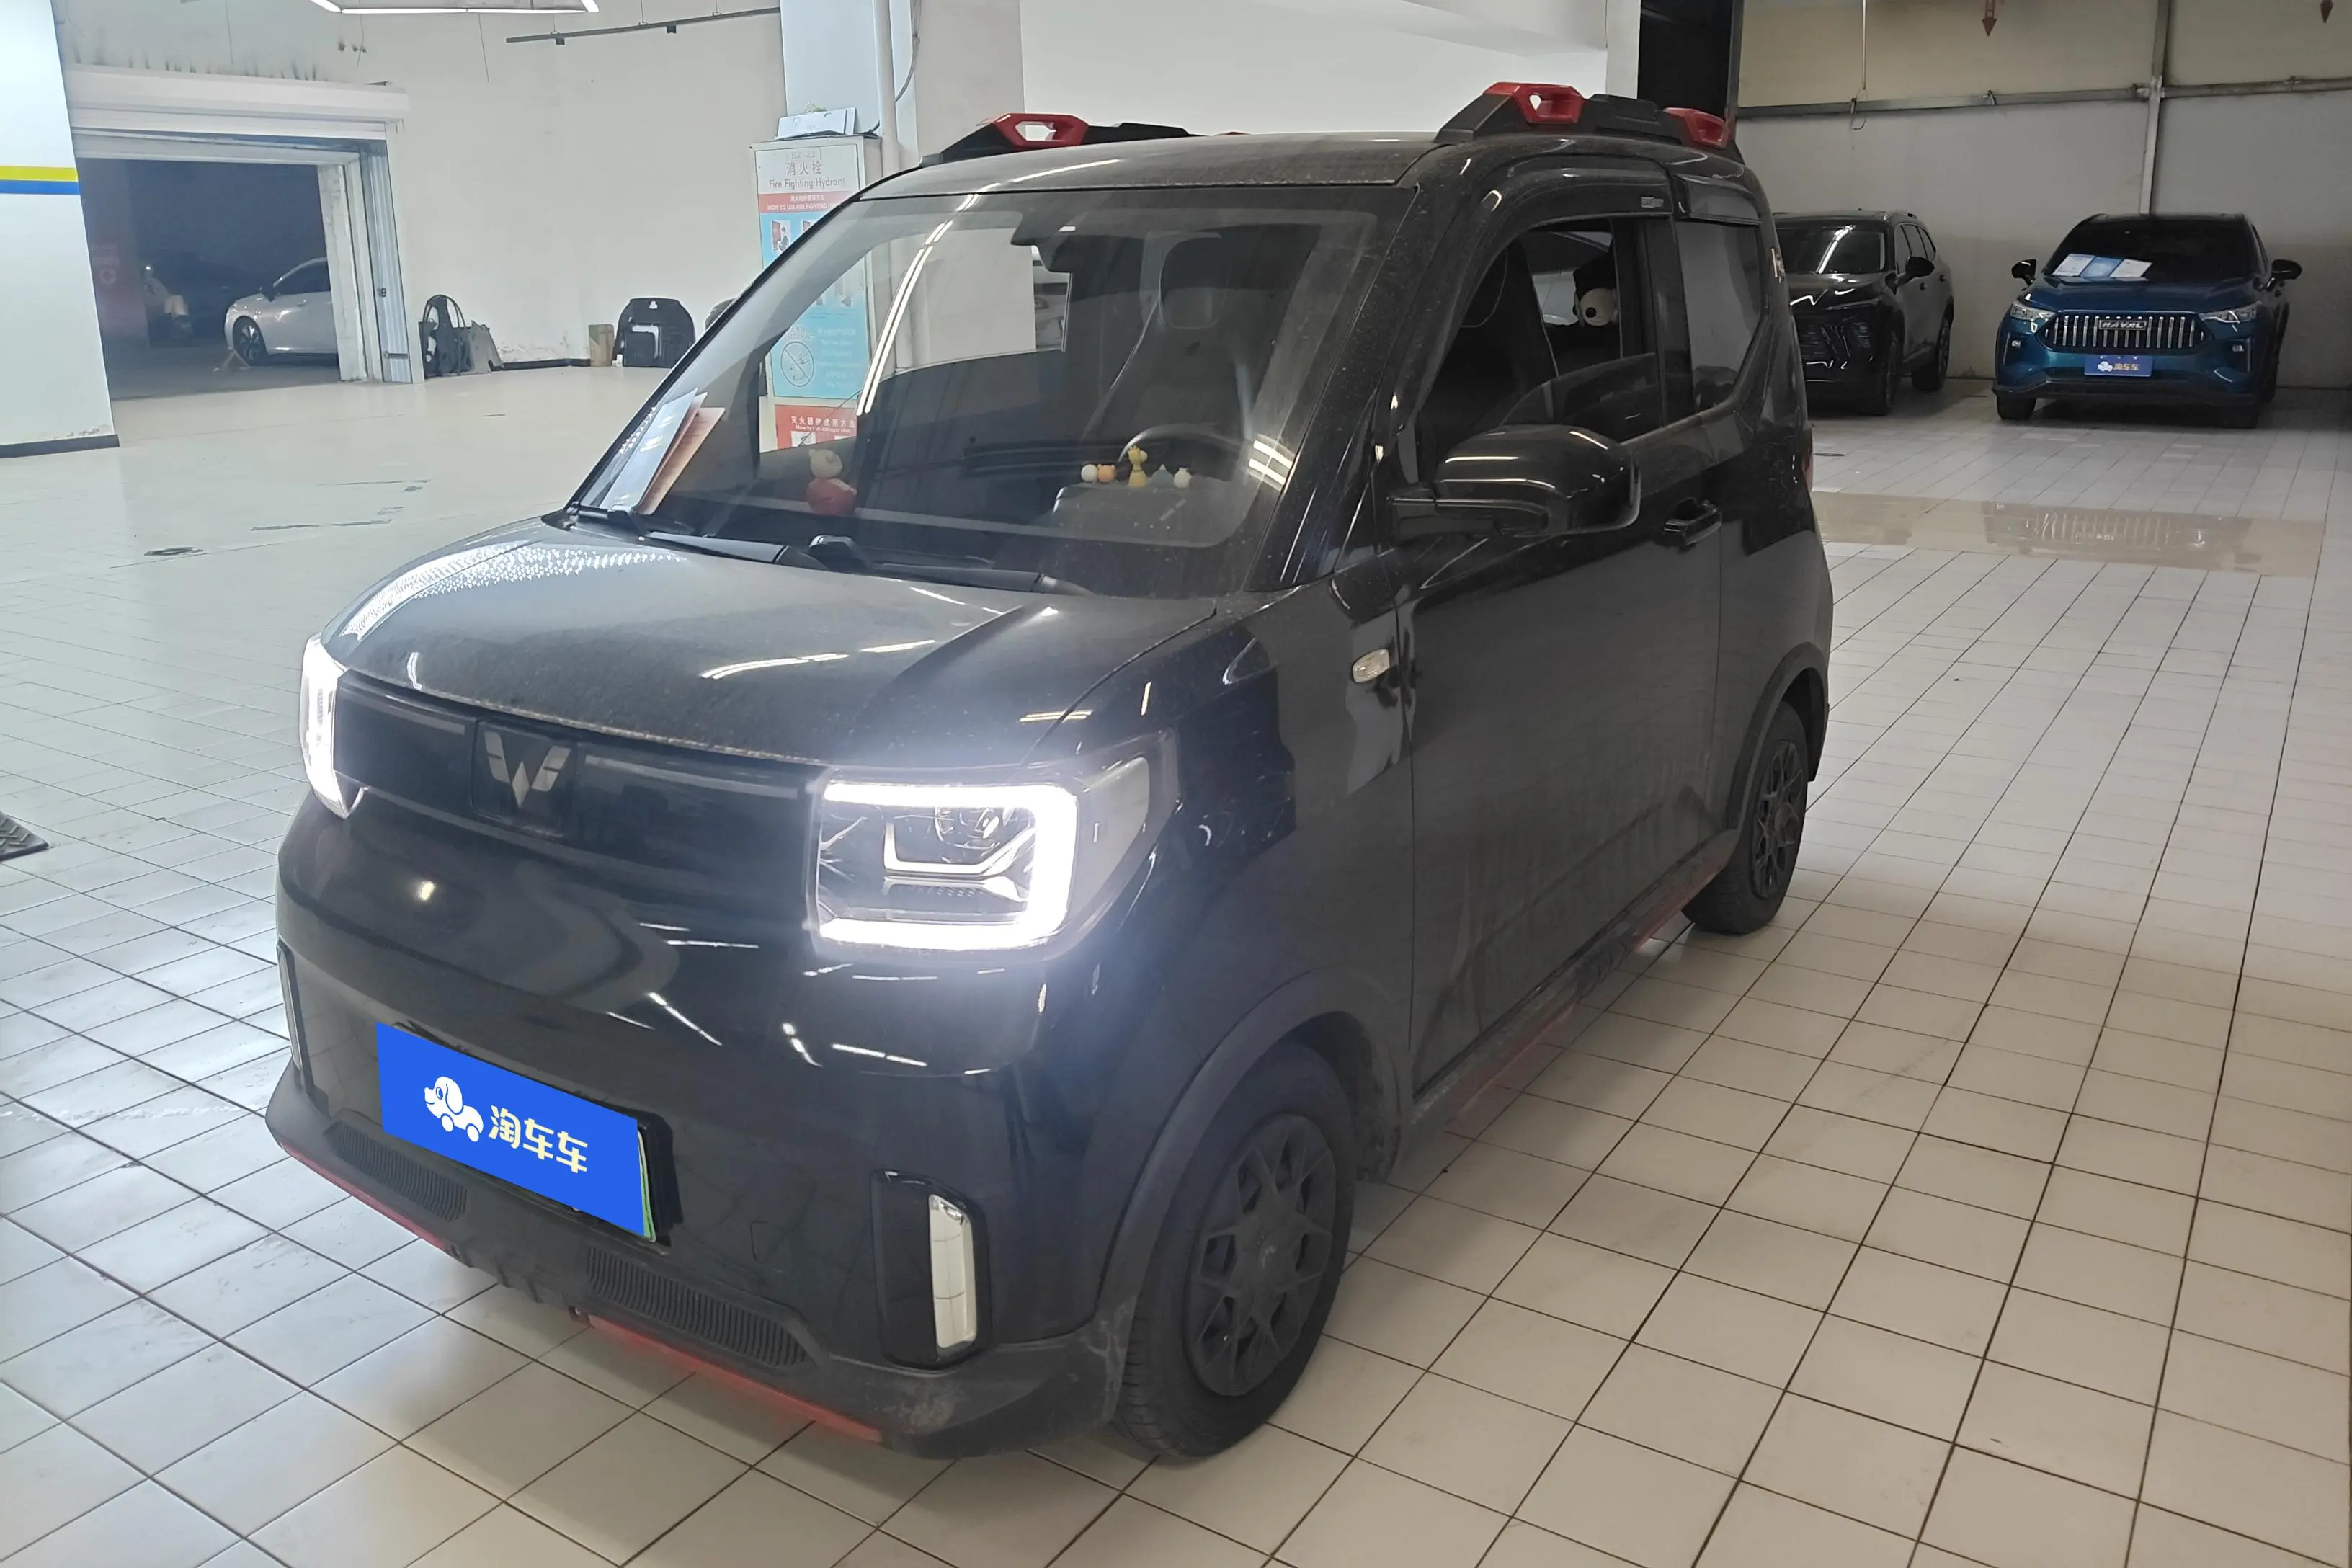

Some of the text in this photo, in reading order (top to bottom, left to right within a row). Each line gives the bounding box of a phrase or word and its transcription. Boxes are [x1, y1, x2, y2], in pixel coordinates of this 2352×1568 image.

[786, 161, 822, 177] 消火栓
[769, 177, 845, 190] Fire Fighting Hydrant
